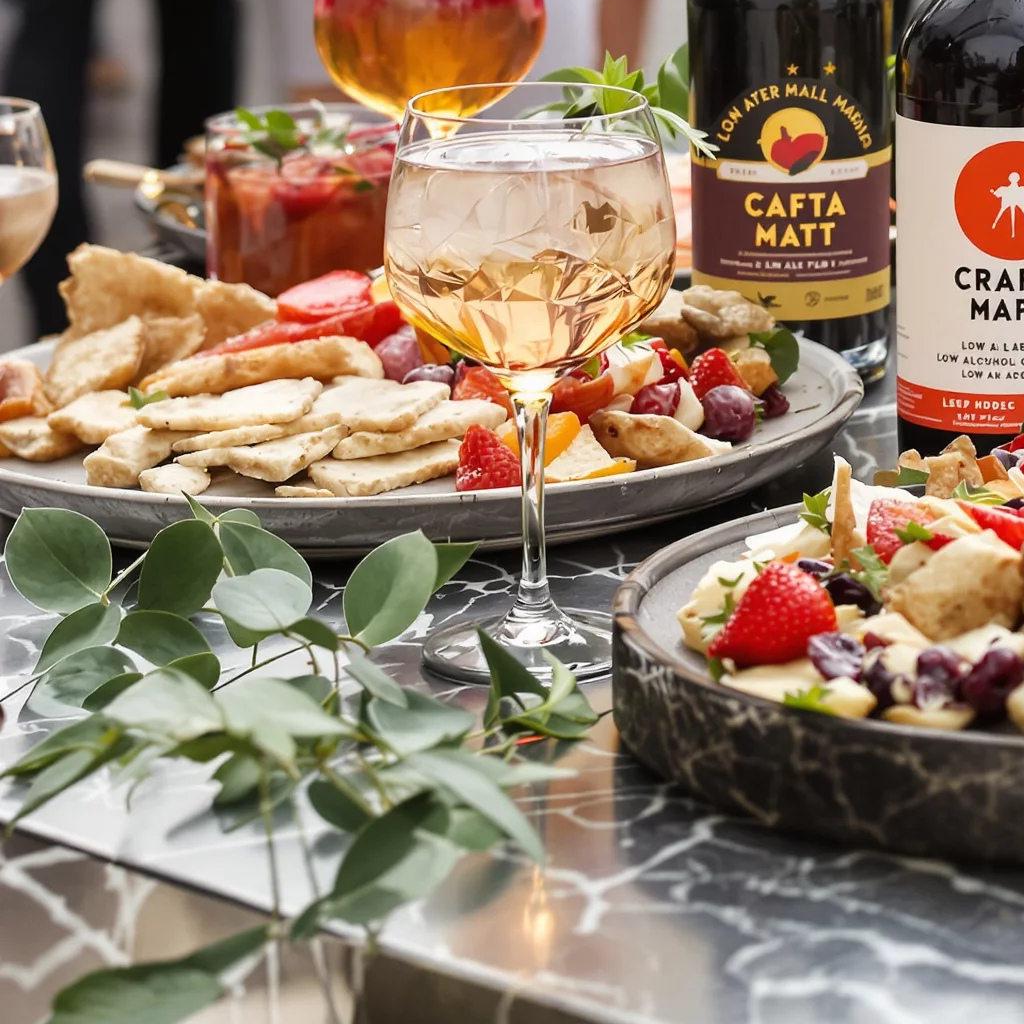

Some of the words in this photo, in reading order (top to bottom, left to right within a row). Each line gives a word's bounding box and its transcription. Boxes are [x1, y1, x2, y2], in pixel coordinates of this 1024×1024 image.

[744, 191, 846, 218] CAFTA
[755, 222, 836, 247] MATT
[961, 341, 985, 351] LOW
[936, 352, 959, 363] LOW
[961, 369, 983, 379] LOW
